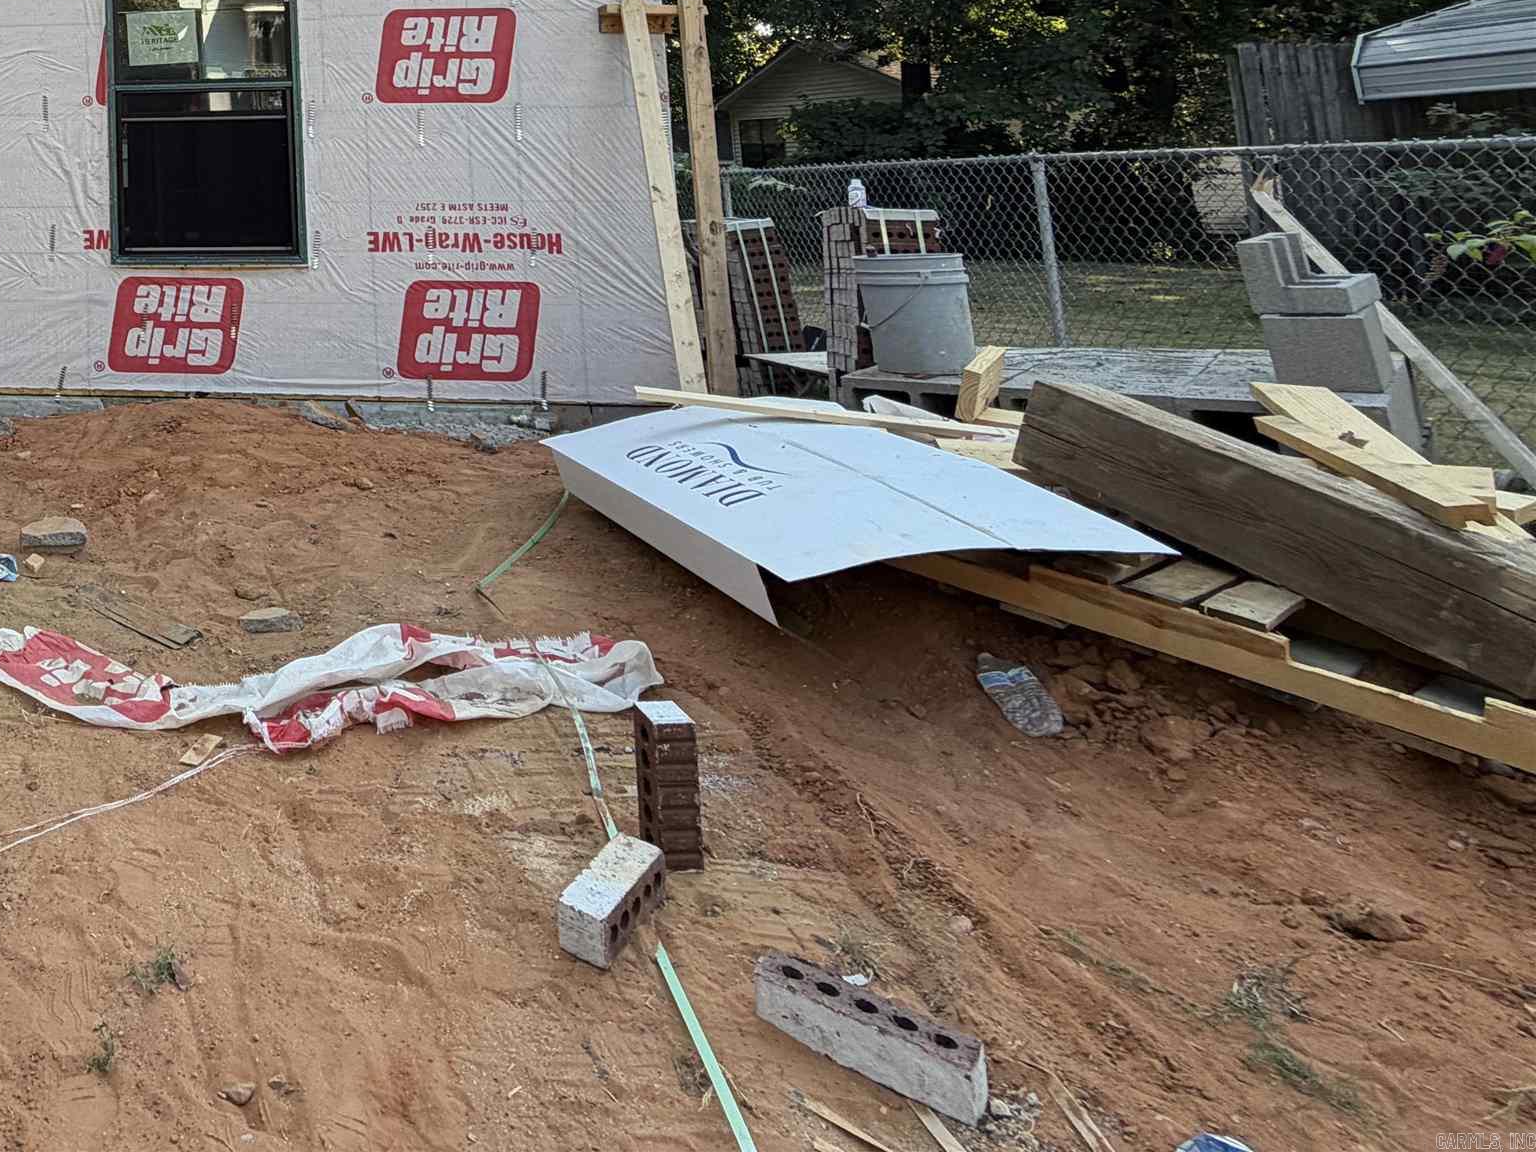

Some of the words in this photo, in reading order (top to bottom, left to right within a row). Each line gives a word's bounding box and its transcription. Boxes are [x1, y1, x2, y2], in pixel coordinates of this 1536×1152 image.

[400, 15, 498, 53] Rite
[392, 52, 495, 95] Grip
[415, 202, 436, 212] 2357
[440, 202, 446, 212] E
[448, 202, 474, 212] ASTM
[477, 202, 508, 212] MEETS
[366, 228, 563, 255] House-Wrap-LWE
[414, 261, 514, 272] www.grip-rite.com
[133, 284, 226, 322] Rite
[422, 288, 522, 327] Rite
[124, 320, 224, 366] Grip
[414, 326, 520, 373] Grip
[626, 445, 767, 507] DIAMOND
